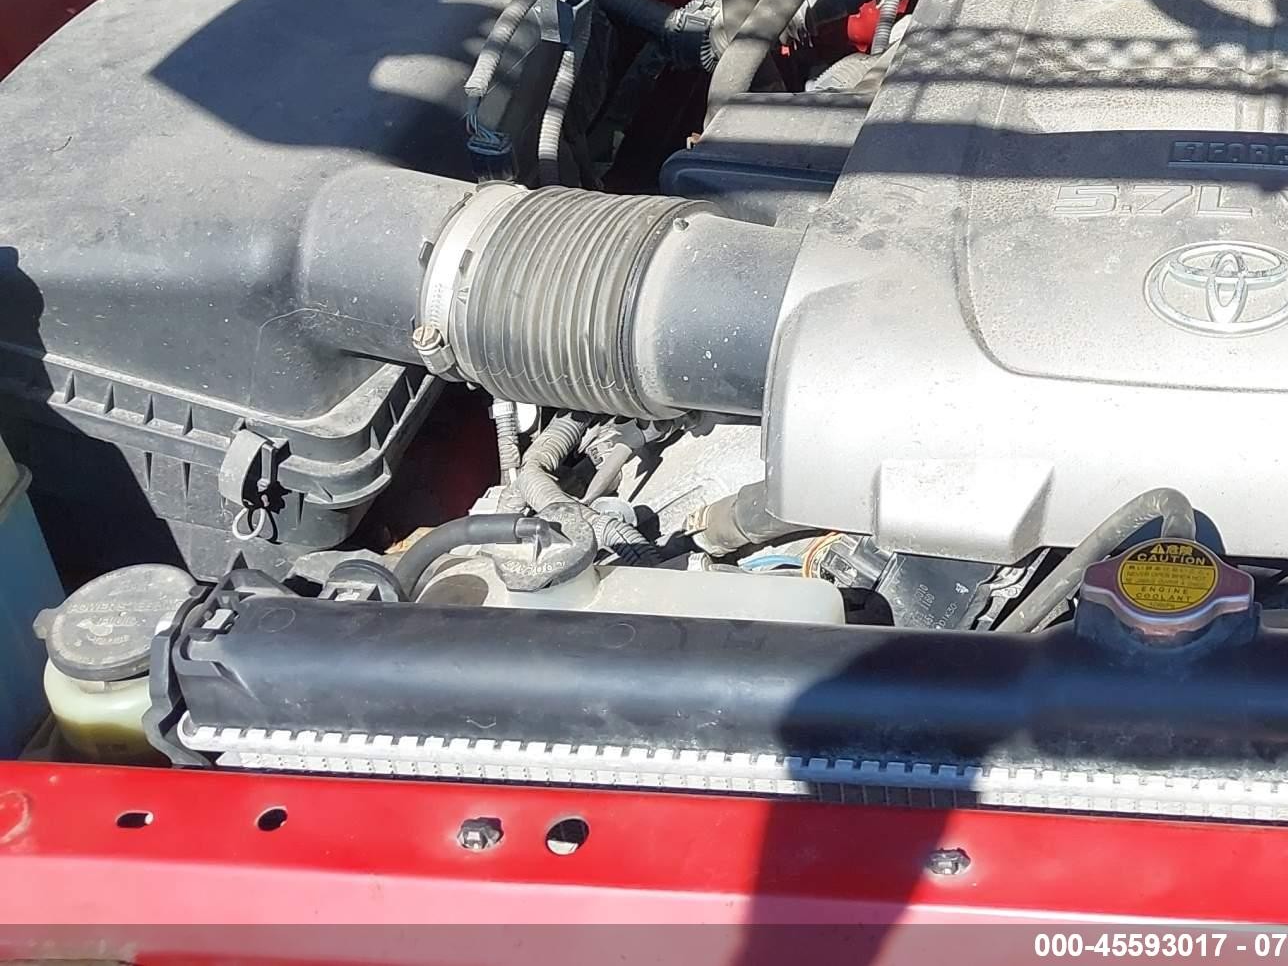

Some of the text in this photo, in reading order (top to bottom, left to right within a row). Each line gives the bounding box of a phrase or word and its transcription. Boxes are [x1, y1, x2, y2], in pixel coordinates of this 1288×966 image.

[1053, 185, 1252, 218] 5.7L
[1137, 553, 1206, 566] CAUTION
[1141, 586, 1188, 594] ENGINE
[1135, 593, 1192, 602] COOLANT
